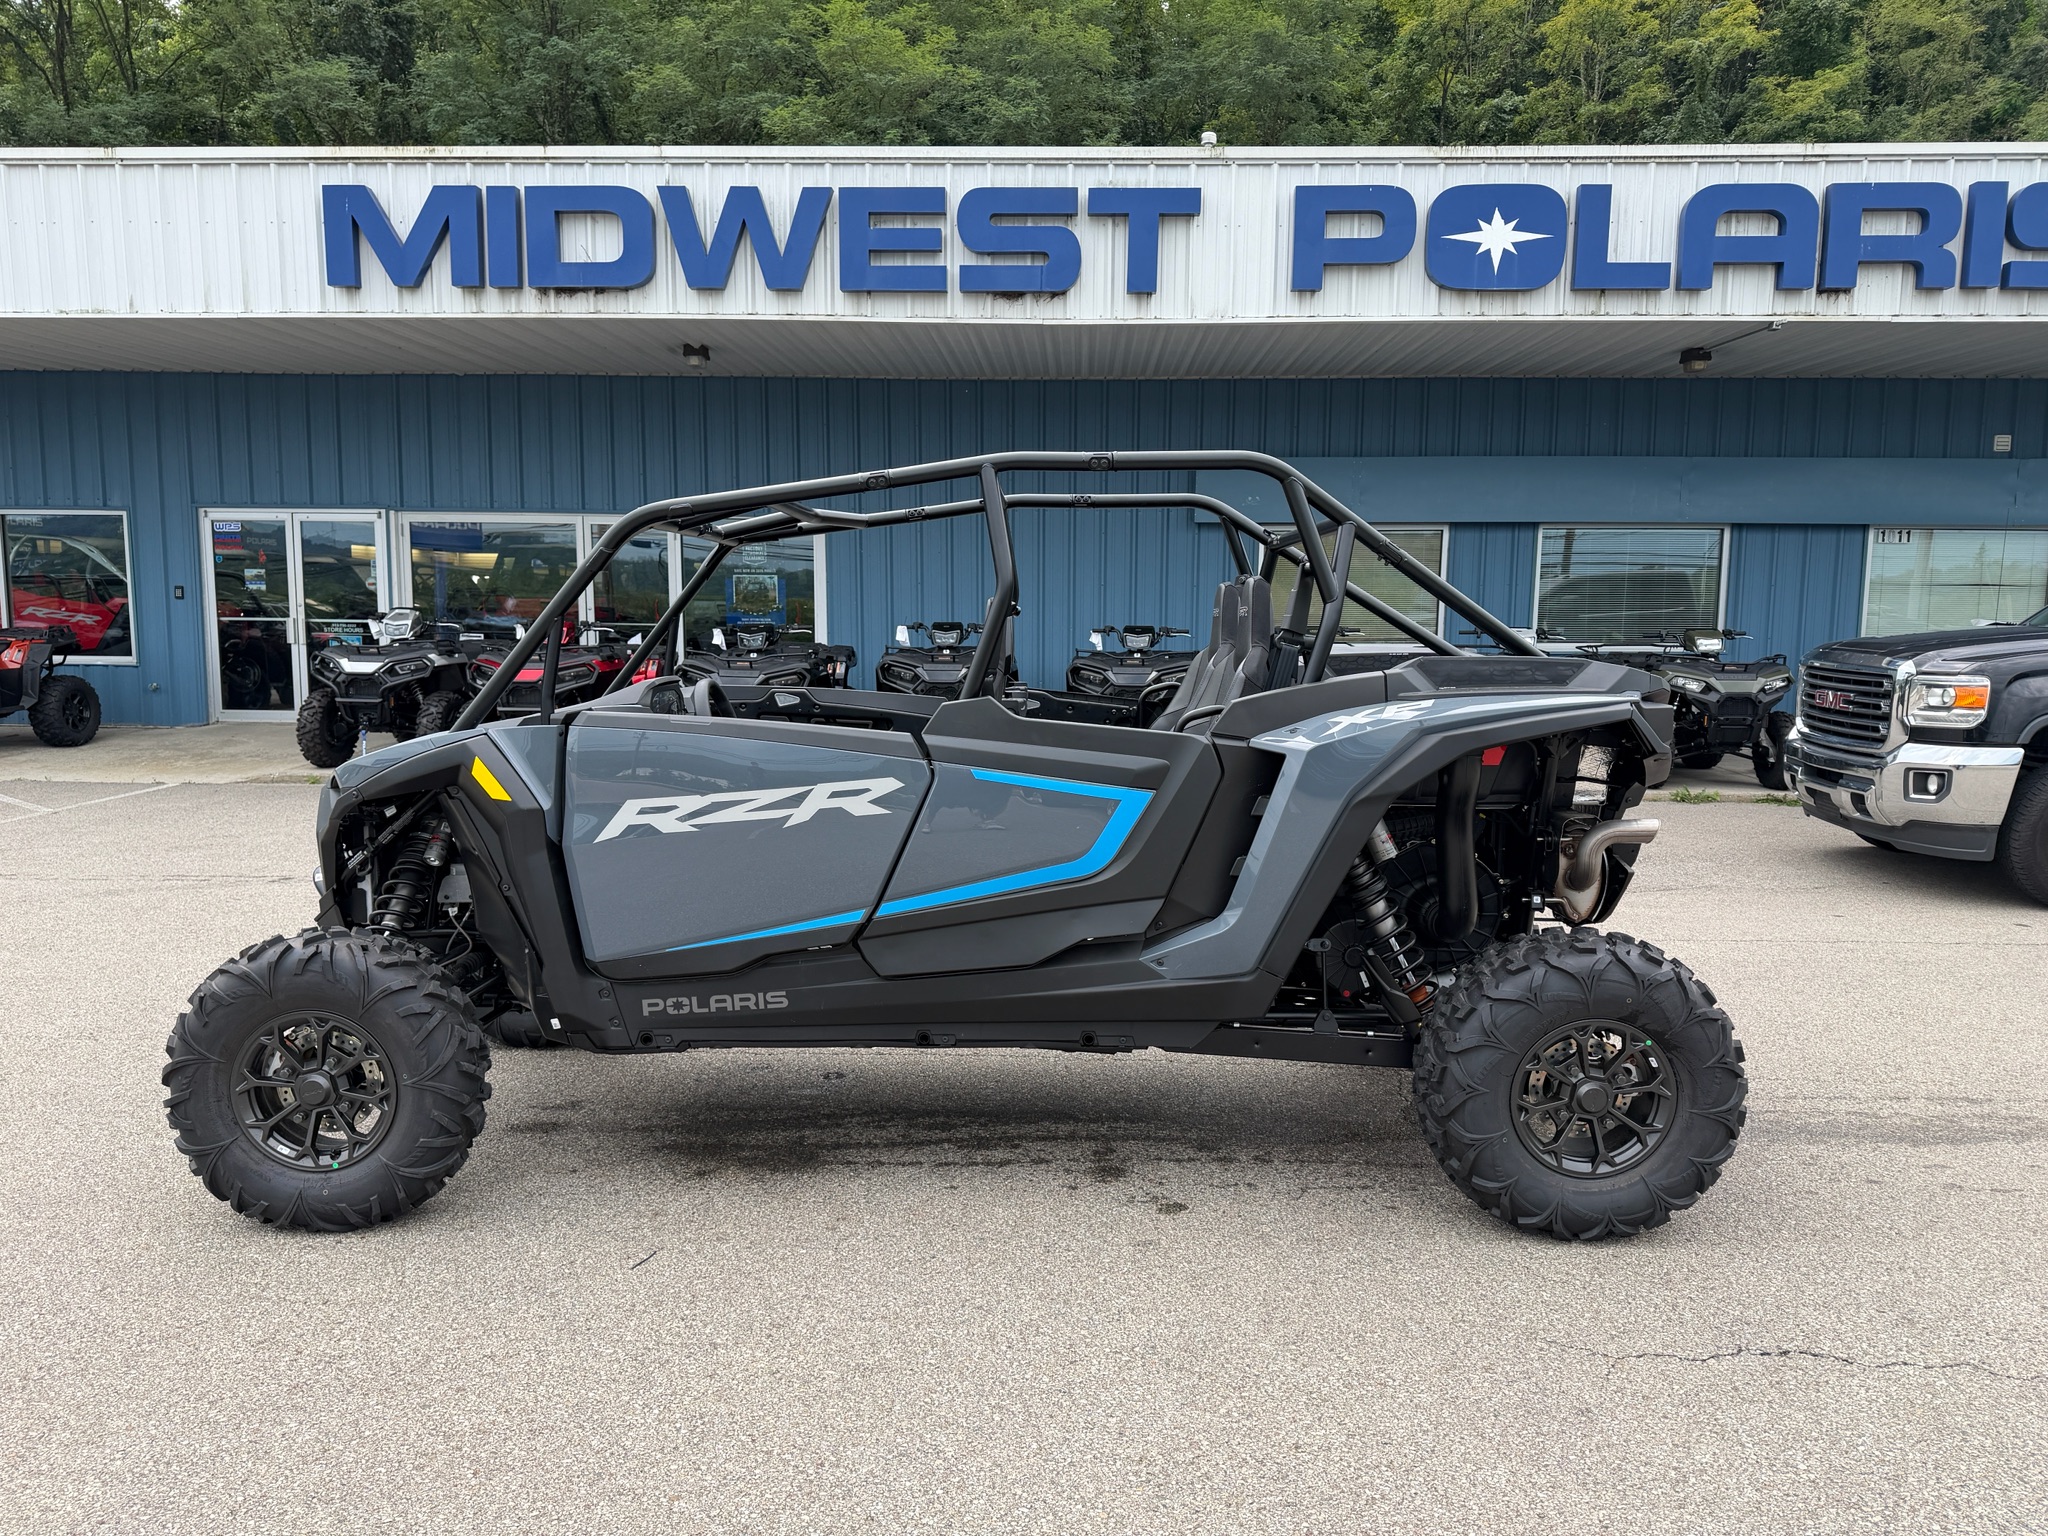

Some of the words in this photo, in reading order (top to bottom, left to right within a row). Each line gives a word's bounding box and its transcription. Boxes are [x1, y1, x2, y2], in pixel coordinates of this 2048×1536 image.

[322, 184, 1201, 294] MIDWEST
[214, 523, 241, 531] WPS
[246, 536, 277, 546] POLARIS
[20, 606, 103, 625] RZR
[1815, 690, 1854, 711] GMC
[593, 777, 905, 843] RZR
[642, 991, 789, 1016] POLARIS
